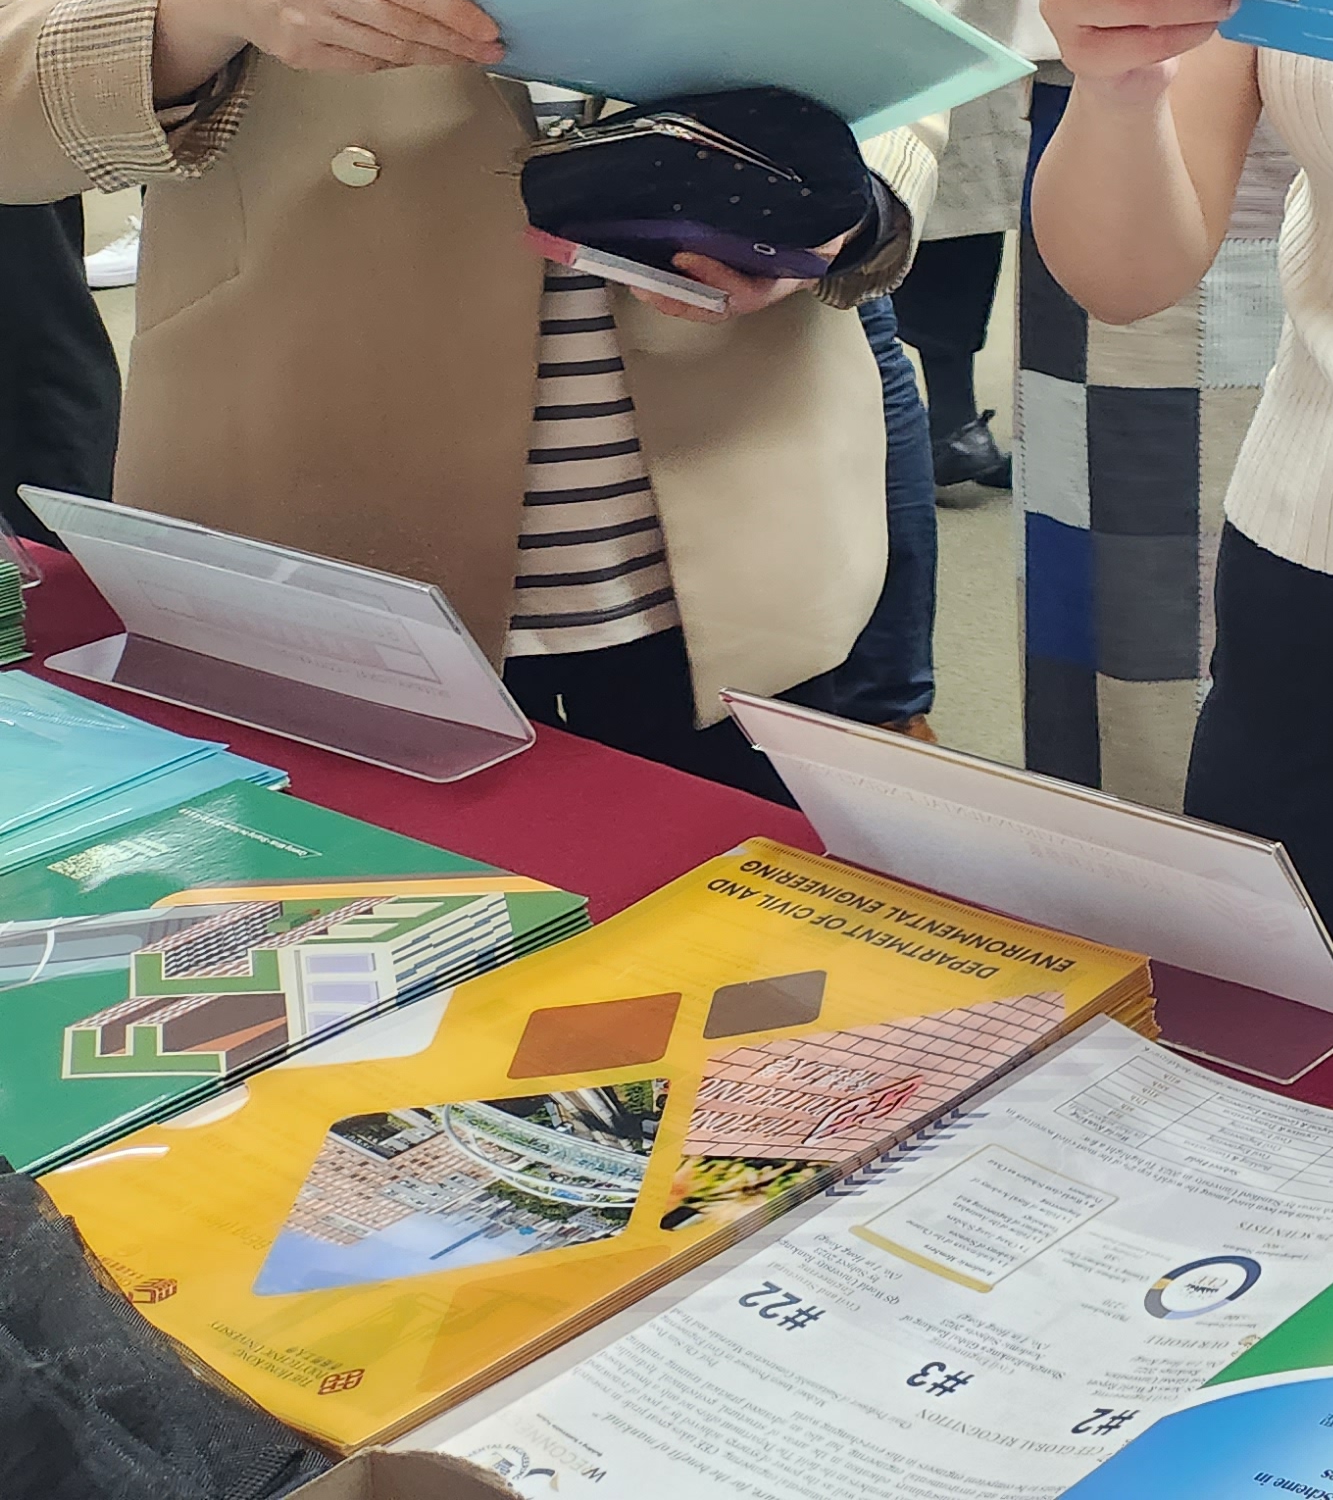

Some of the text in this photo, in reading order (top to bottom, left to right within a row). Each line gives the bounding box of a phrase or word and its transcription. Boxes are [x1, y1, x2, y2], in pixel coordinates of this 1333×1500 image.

[706, 876, 999, 979] DEPARTMENT OF CIVIL AND
[738, 858, 1075, 973] ENVIRONMENTAL ENGINEERING
[814, 1258, 861, 1284] University
[858, 1282, 884, 1297] World
[883, 1295, 899, 1305] QS
[737, 1281, 825, 1332] #22
[1142, 1335, 1229, 1349] OUR PEOPLE
[904, 1362, 974, 1397] #3
[914, 1409, 1018, 1445] RECOGNITION
[1068, 1409, 1139, 1435] #2
[506, 1418, 606, 1481] WECONNE
[655, 1440, 671, 1451] of
[669, 1448, 709, 1471] benefit
[707, 1467, 729, 1482] the
[728, 1478, 749, 1492] for
[1253, 1471, 1273, 1484] in
